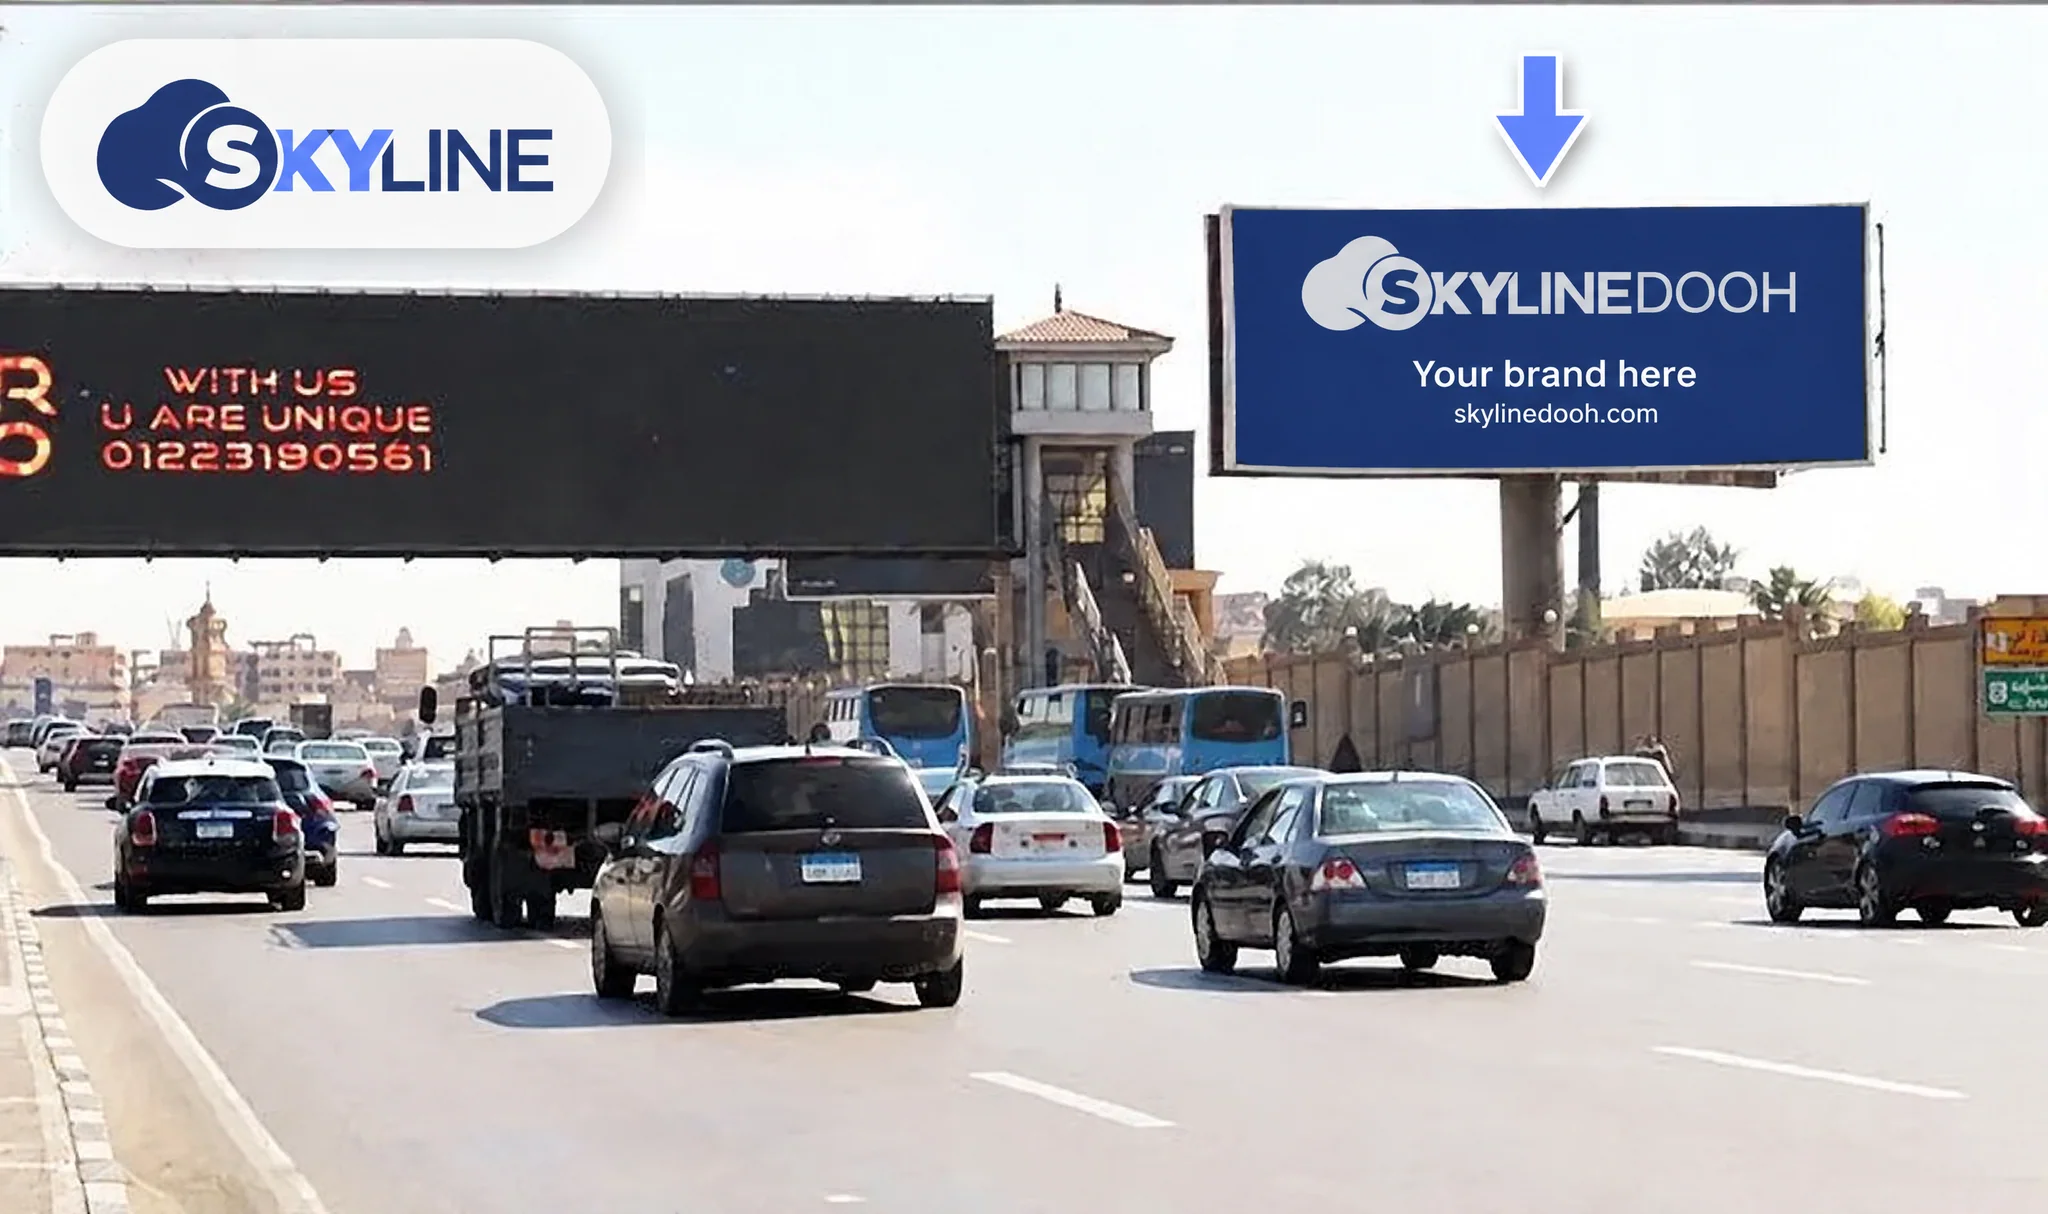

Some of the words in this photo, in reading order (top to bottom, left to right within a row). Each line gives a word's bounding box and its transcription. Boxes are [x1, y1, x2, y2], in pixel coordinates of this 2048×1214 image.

[164, 367, 278, 395] WITH
[293, 368, 358, 397] US
[1413, 360, 1494, 388] Your
[1504, 359, 1606, 388] brand
[1619, 359, 1697, 388] here
[101, 404, 133, 431] U
[149, 404, 247, 431] ARE
[262, 404, 432, 434] UNIQUE
[1454, 402, 1658, 429] skylinedooh.com
[102, 439, 433, 472] 01223190561
